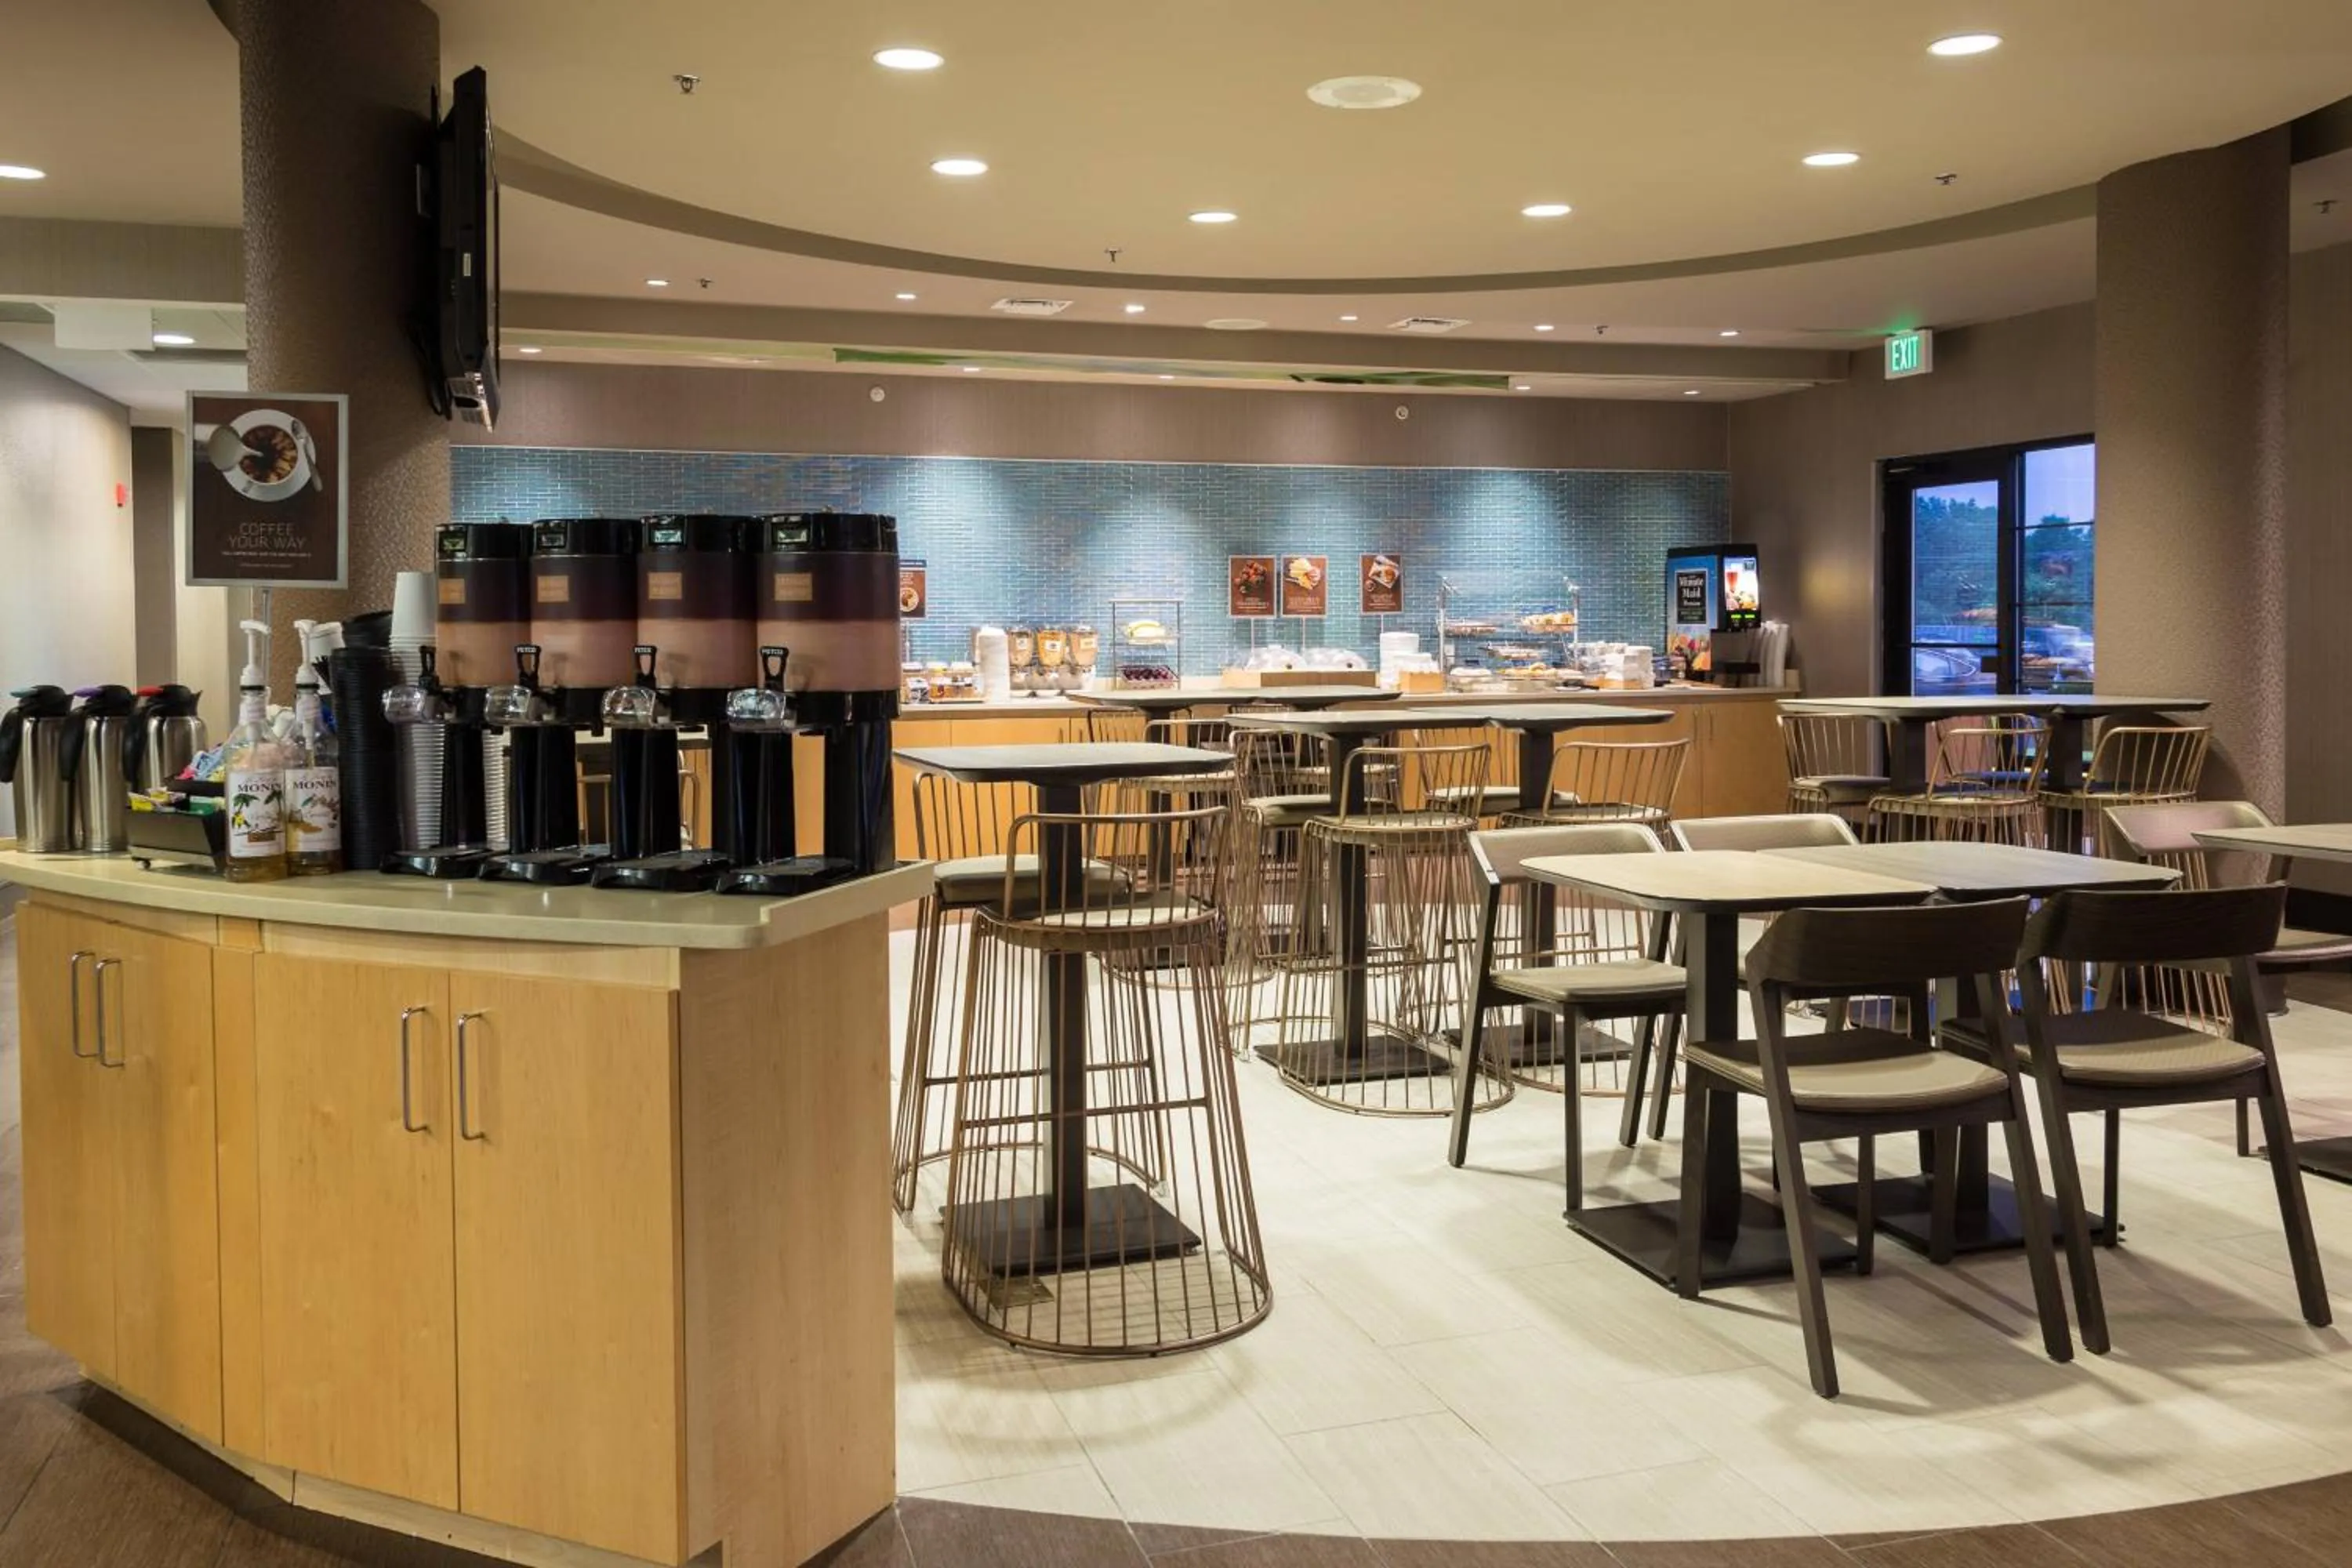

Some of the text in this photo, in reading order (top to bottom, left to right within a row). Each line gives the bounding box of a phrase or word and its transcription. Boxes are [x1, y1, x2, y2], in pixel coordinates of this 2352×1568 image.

[1892, 336, 1919, 371] EXIT
[239, 522, 294, 535] COFFEE
[229, 535, 306, 550] YOUR WAY
[238, 783, 281, 793] MONIN
[293, 780, 337, 789] MONIN
